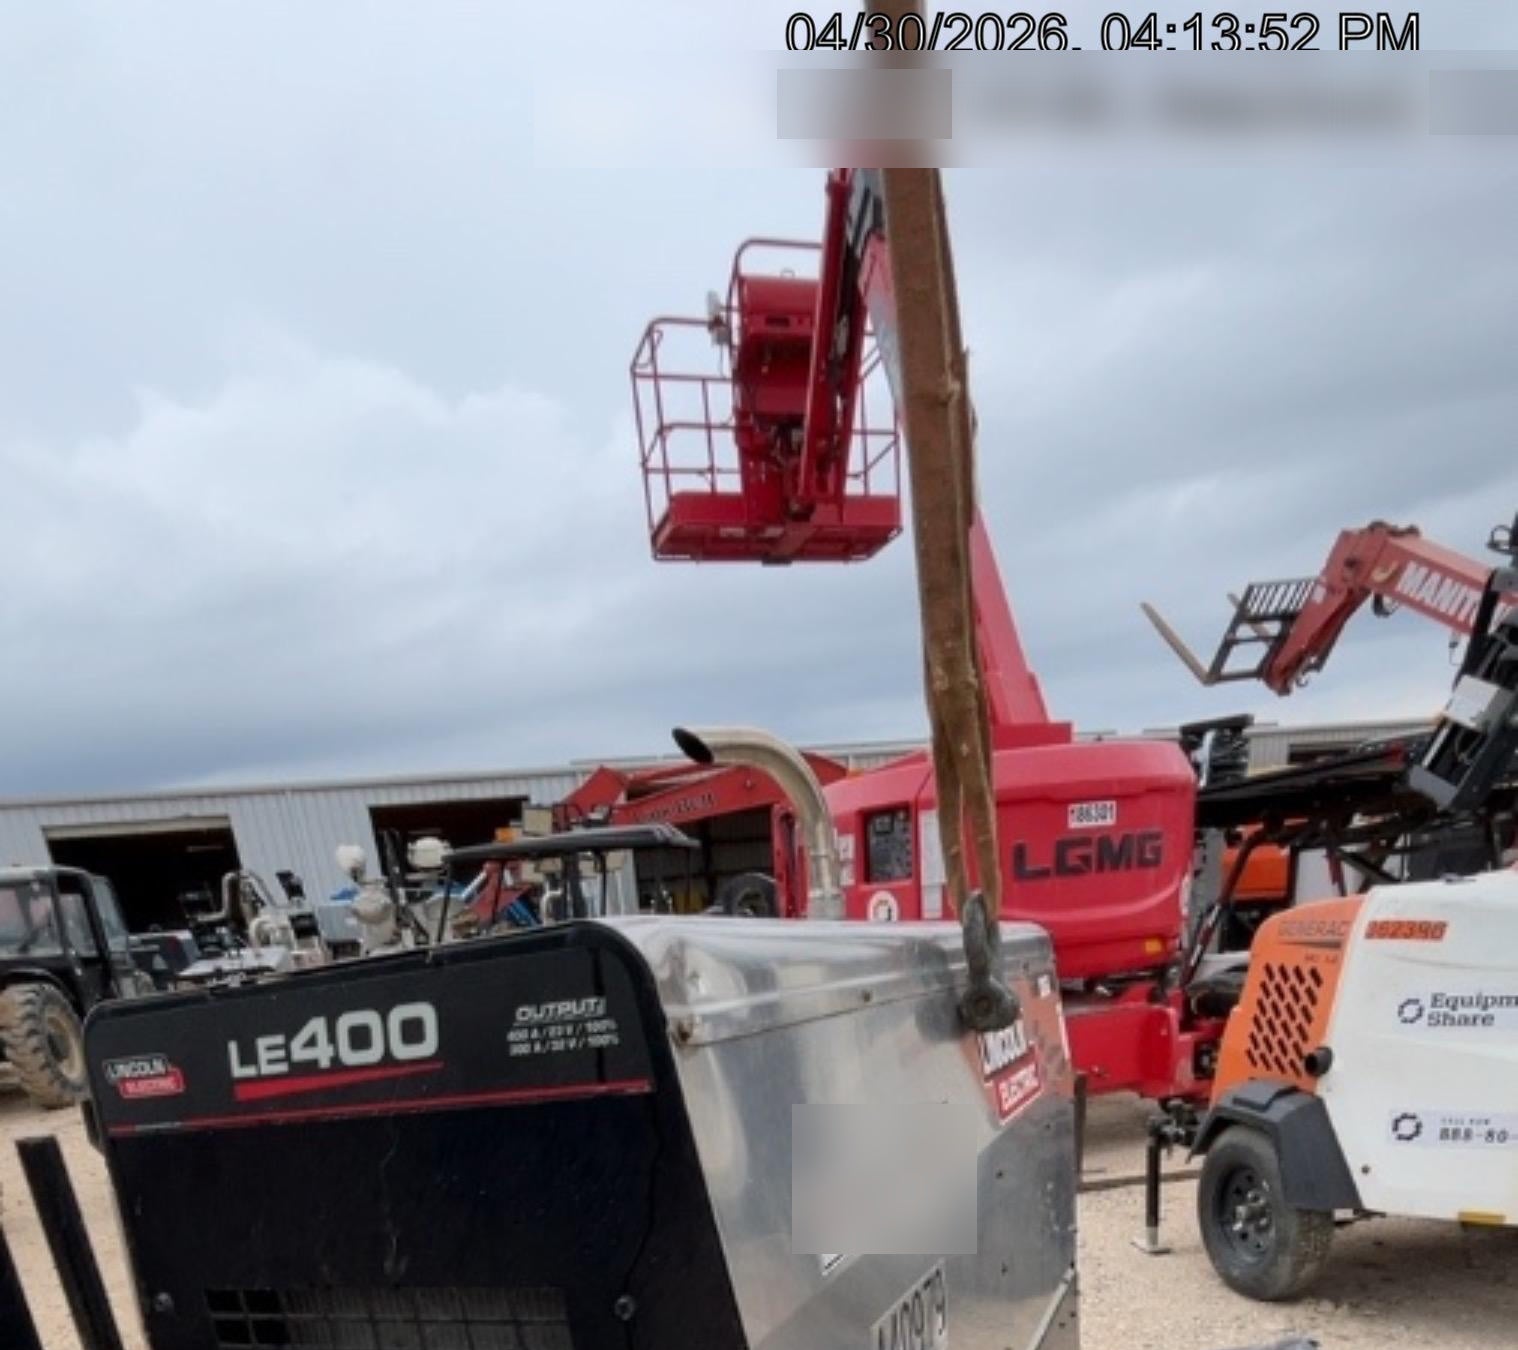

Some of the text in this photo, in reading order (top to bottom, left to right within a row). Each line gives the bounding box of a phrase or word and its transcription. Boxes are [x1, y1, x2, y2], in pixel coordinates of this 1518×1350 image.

[1013, 830, 1163, 880] LGMG
[1427, 1011, 1495, 1027] Share
[227, 1002, 438, 1079] LE400
[104, 1056, 168, 1079] LINCOLN
